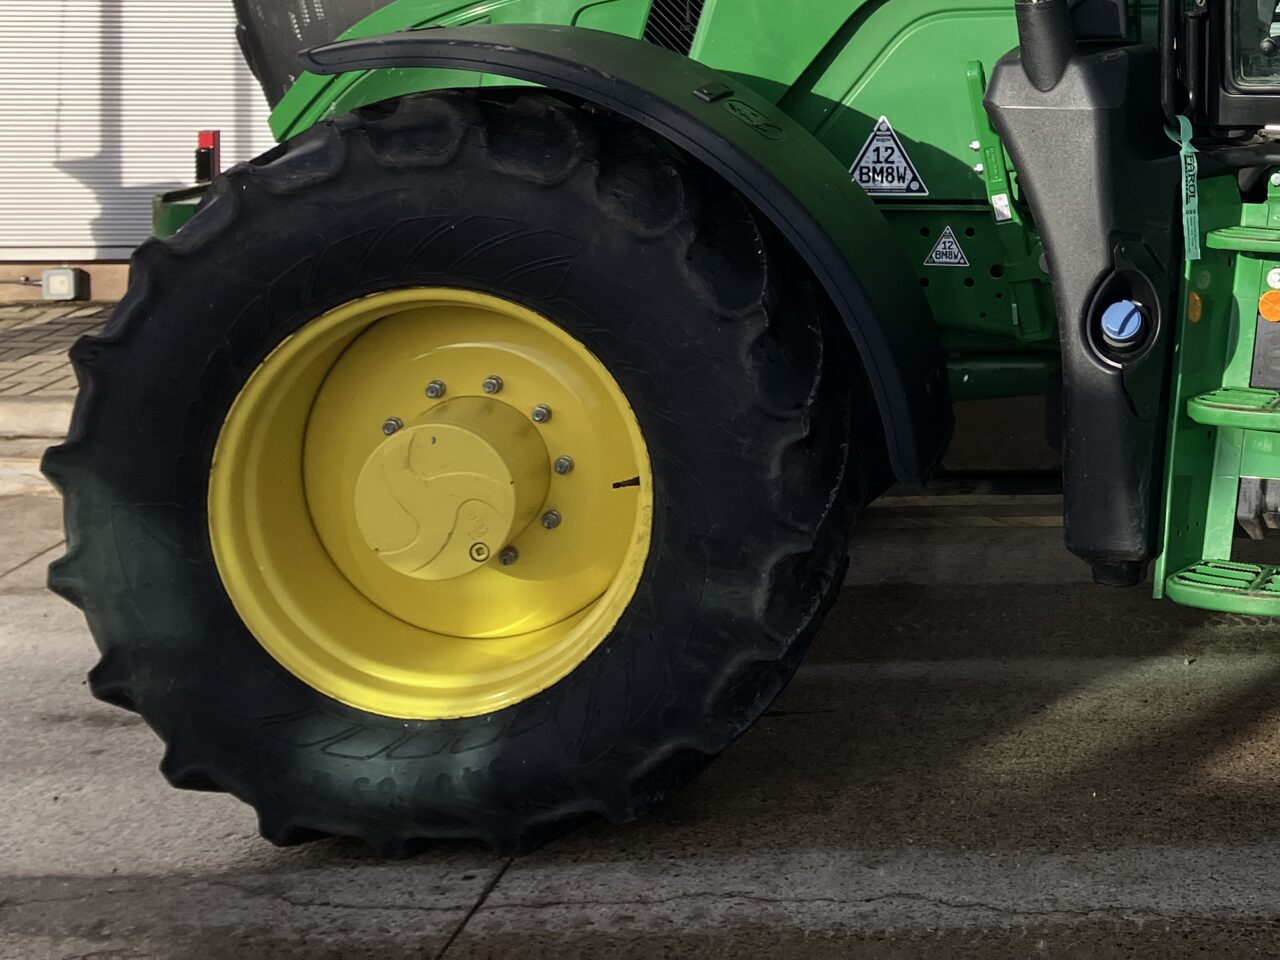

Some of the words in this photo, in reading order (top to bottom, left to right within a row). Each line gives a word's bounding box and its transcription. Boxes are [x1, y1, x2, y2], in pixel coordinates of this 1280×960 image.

[871, 146, 896, 165] 12
[859, 165, 908, 185] BM8W
[941, 240, 954, 251] 12
[934, 250, 960, 260] BM8W
